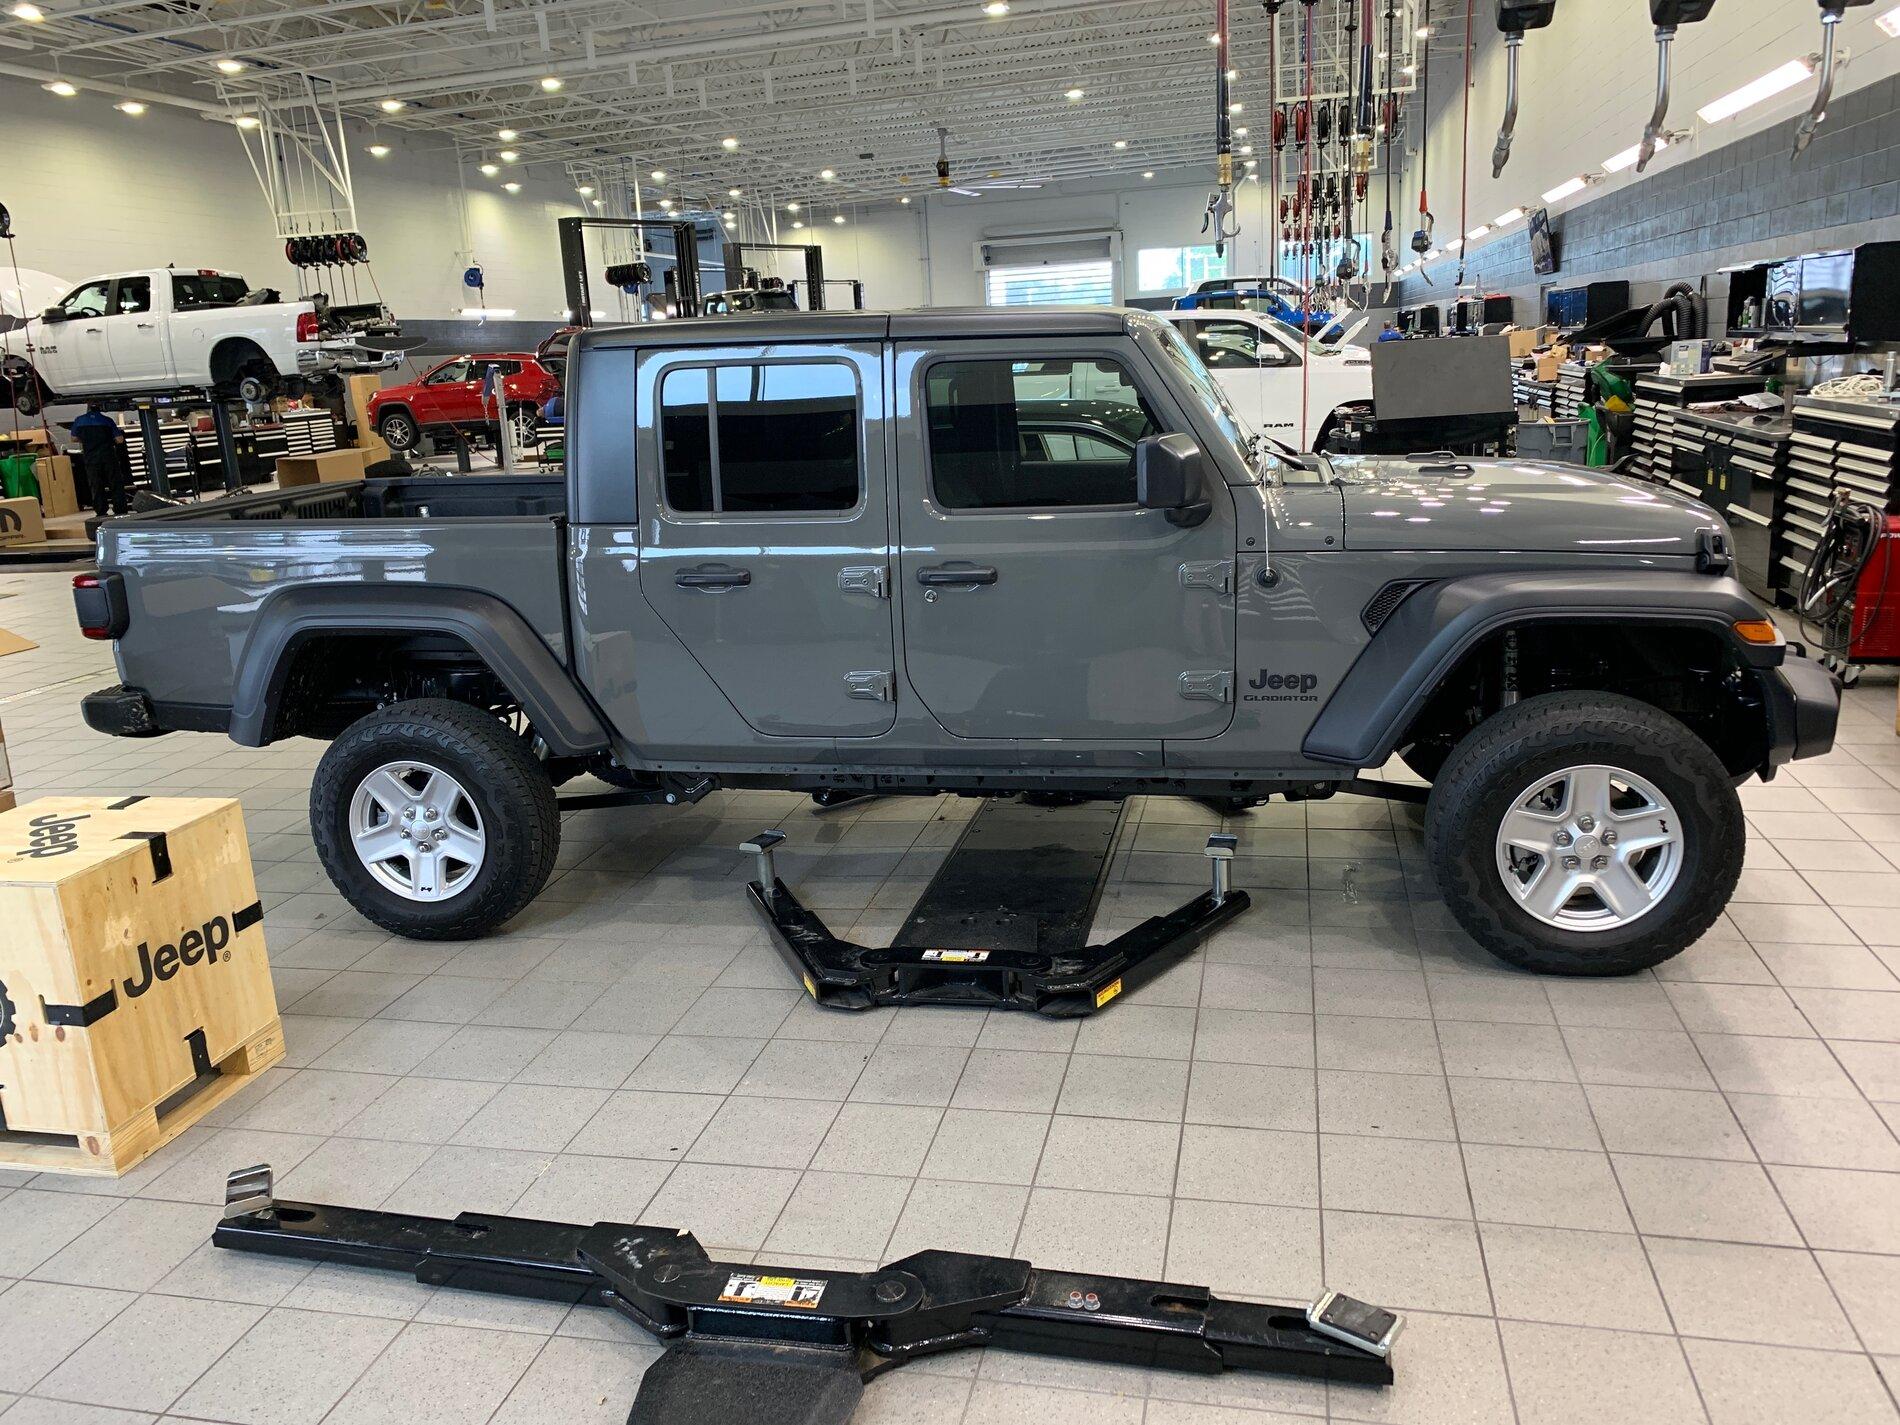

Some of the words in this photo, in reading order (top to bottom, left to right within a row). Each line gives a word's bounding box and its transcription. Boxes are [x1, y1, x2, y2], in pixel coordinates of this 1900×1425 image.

[1243, 694, 1319, 702] GLADIATOR
[1248, 668, 1318, 694] Jeep
[16, 813, 91, 859] Jeep
[122, 915, 229, 998] Jeep
